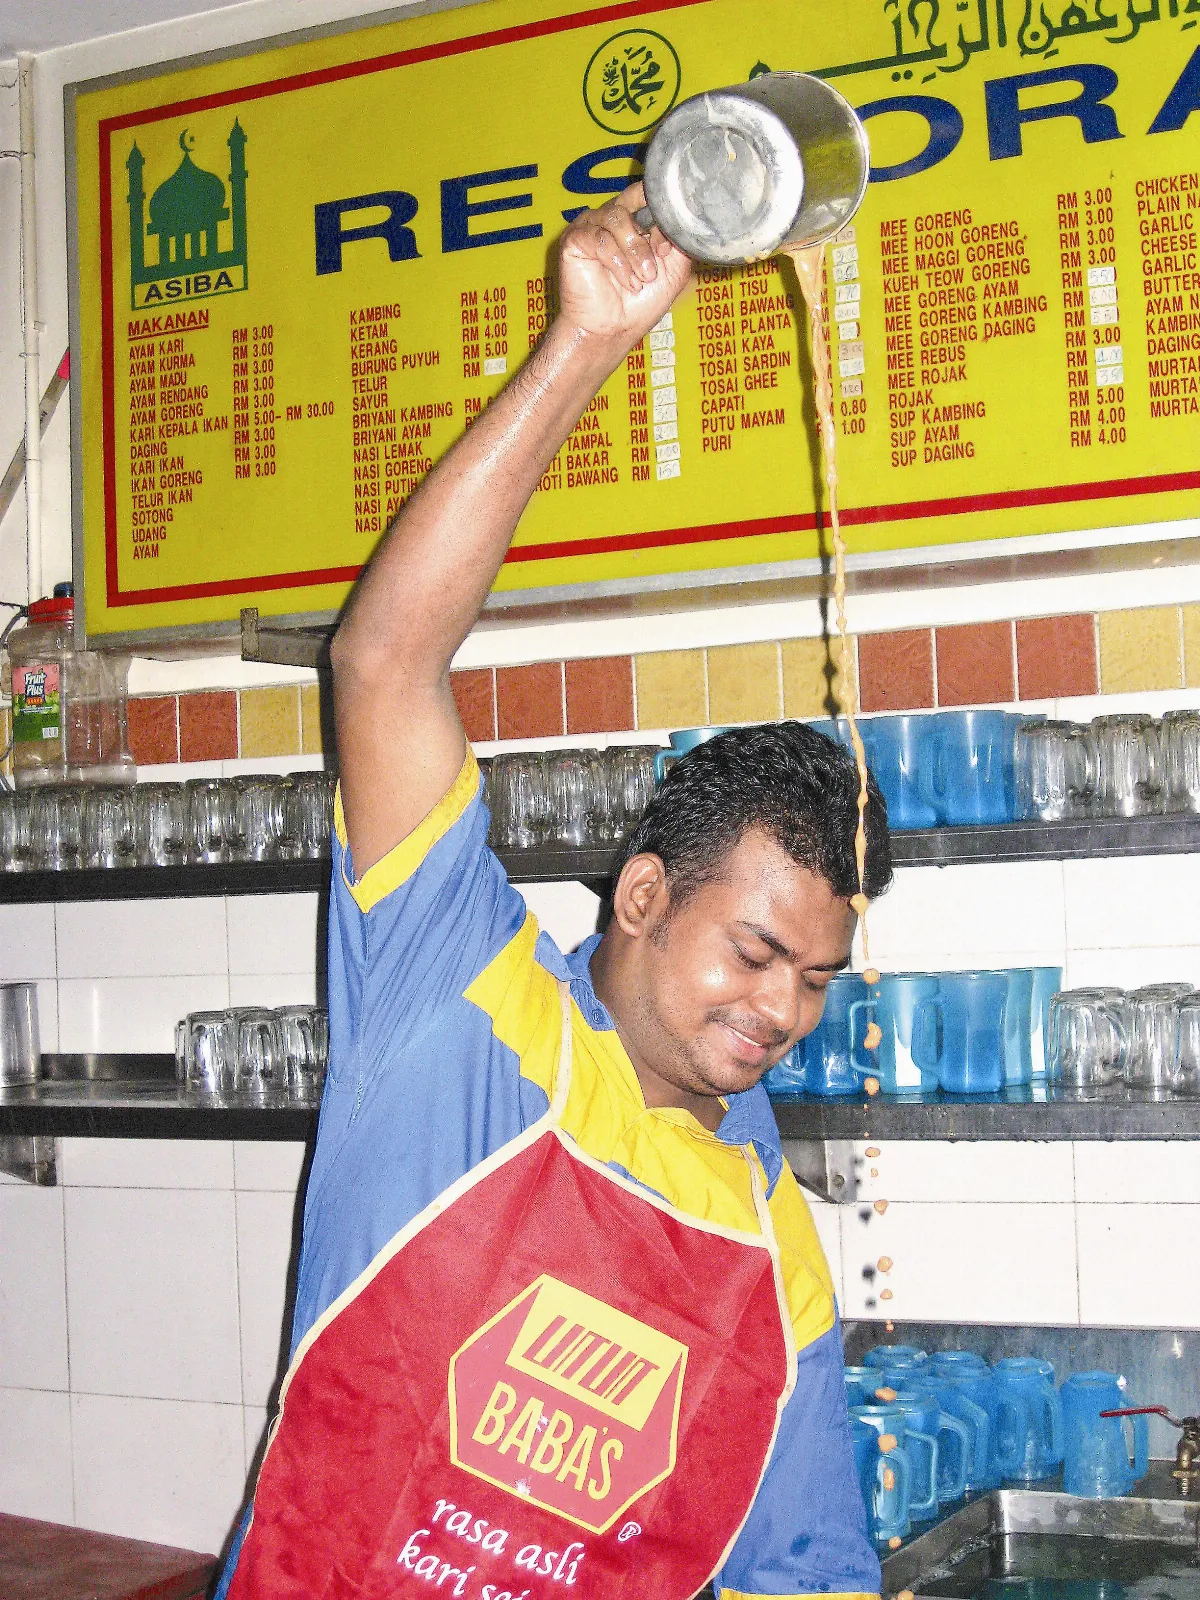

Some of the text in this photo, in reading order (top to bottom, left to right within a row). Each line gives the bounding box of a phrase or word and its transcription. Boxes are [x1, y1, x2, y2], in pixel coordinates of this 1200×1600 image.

[1135, 172, 1200, 198] CHICKEN
[1057, 187, 1113, 210] RM 3.00
[1137, 196, 1181, 216] PLAIN
[880, 218, 908, 237] MEE
[914, 208, 973, 233] GORENG
[1057, 207, 1113, 229] RM 3.00
[1139, 213, 1193, 237] GARLIC
[880, 237, 908, 256] MEE
[914, 231, 955, 252] HOON
[960, 220, 1019, 245] GORENG
[1141, 233, 1197, 257] CHEESE
[881, 256, 909, 275] MEE
[915, 249, 960, 270] MAGGI
[965, 239, 1025, 264] GORENG
[1060, 246, 1116, 269] RM 3.00
[1142, 253, 1197, 277] GARLIC
[694, 258, 781, 286] TOSAI TELUR
[883, 257, 1031, 294] KUEH TEOW GORENG
[144, 271, 234, 303] ASIBA
[460, 286, 507, 307] RM 4.00
[695, 279, 769, 304] TOSAI TISU
[883, 279, 1019, 313] MEE GORENG AYAM
[349, 303, 401, 326] KAMBING
[696, 292, 795, 322] TOSAI BAWANG
[884, 313, 913, 333] MEE
[919, 304, 977, 329] GORENG
[983, 295, 1048, 319] KAMBING
[1145, 295, 1184, 316] AYAM
[127, 308, 210, 337] MAKANAN
[232, 324, 274, 342] RM 3.00
[349, 322, 389, 342] KETAM
[461, 322, 507, 341] RM 4.00
[697, 321, 735, 341] TOSAI
[741, 313, 791, 335] PLANTA
[885, 316, 1036, 352] MEE GORENG DAGING
[698, 340, 737, 360] TOSAI
[741, 334, 775, 353] KAYA
[1065, 326, 1121, 348] RM 3.00
[129, 338, 185, 360] AYAM KARI
[350, 339, 398, 360] KERANG
[462, 340, 508, 360] RM 5.00
[887, 351, 914, 371] MEE
[920, 344, 966, 365] REBUS
[129, 354, 195, 377] AYAM KURMA
[351, 352, 440, 377] BURUNG PUYUH
[699, 358, 737, 377] TOSAI
[743, 351, 791, 373] SARDIN
[130, 371, 187, 393] AYAM MADU
[352, 375, 388, 394] TELUR
[700, 377, 739, 396] TOSAI
[743, 371, 778, 391] GHEE
[887, 365, 967, 390] MEE ROJAK
[130, 385, 209, 410] AYAM RENDANG
[352, 392, 389, 413] SAYUR
[701, 395, 745, 416] CAPATI
[840, 398, 868, 417] 0.80
[888, 389, 934, 409] ROJAK
[1068, 387, 1125, 408] RM 5.00
[130, 401, 204, 426] AYAM GORENG
[233, 413, 250, 428] RM
[285, 406, 303, 420] RM
[307, 401, 335, 419] 30.00
[352, 401, 453, 431] BRIYANI KAMBING
[701, 409, 785, 433] PUTU MAYAM
[889, 401, 986, 429] SUP KAMBING
[129, 416, 229, 443] KARI KEPALA IKAN
[352, 422, 431, 447] BRIYANI AYAM
[841, 417, 867, 435] 1.00
[890, 424, 960, 449] SUP AYAM
[1070, 426, 1127, 447] RM 4.00
[130, 441, 168, 461] DAGING
[353, 442, 423, 463] NASI LEMAK
[566, 431, 613, 452] TAMPAL
[702, 434, 732, 452] PURI
[566, 450, 610, 471] BAKAR
[891, 441, 975, 468] SUP DAGING
[130, 456, 185, 477] KARI IKAN
[234, 461, 277, 479] RM 3.00
[353, 457, 434, 481] NASI GORENG
[566, 466, 620, 488] BAWANG
[631, 464, 651, 481] RM
[130, 471, 203, 493] IKAN GORENG
[354, 476, 419, 497] NASI PUTIH
[132, 489, 193, 510] TELUR IKAN
[355, 499, 381, 515] NASI
[131, 507, 174, 527] SOTONG
[131, 525, 167, 544] UDANG
[132, 544, 160, 559] AYAM
[471, 1381, 624, 1500] BABA'S
[432, 1499, 585, 1585] rasa asli
[397, 1529, 476, 1596] kari
